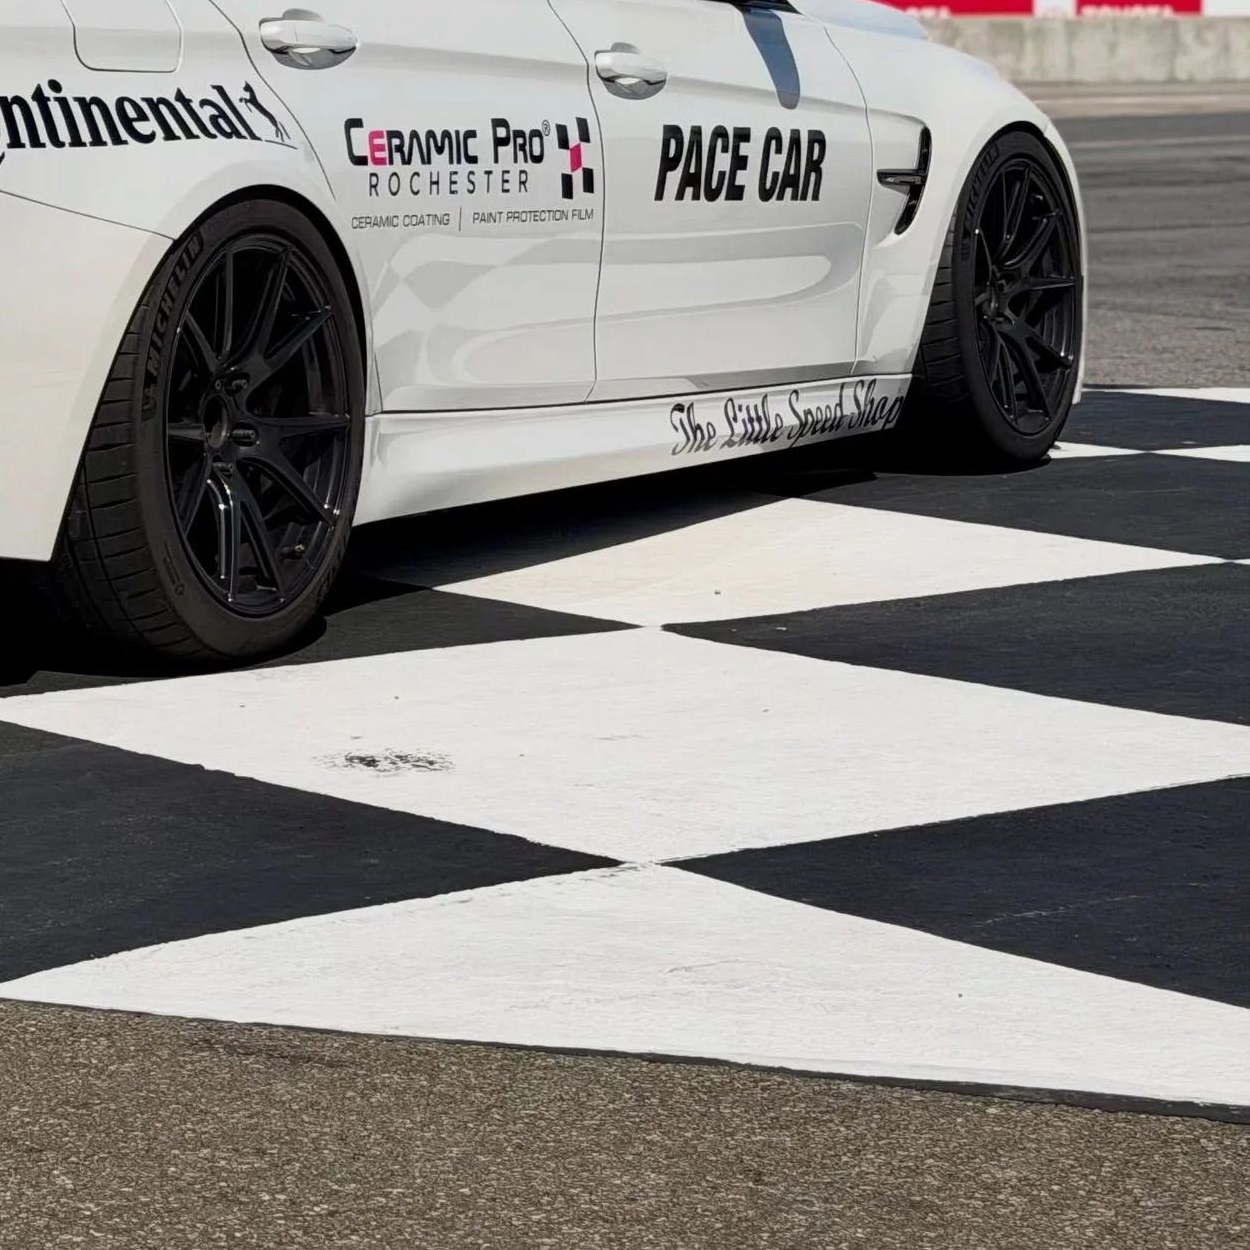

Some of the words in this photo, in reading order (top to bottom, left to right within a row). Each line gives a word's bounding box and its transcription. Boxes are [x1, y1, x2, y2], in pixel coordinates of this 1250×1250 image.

[368, 169, 529, 197] ROCHESTER
[654, 124, 751, 202] PACE
[758, 126, 827, 202] CAR
[351, 215, 399, 230] CERAMIC
[402, 212, 450, 228] COATING
[472, 211, 503, 224] PAINT
[506, 209, 569, 223] PROTECTION
[571, 208, 594, 221] FILM
[146, 235, 201, 377] MICHELIN
[670, 402, 717, 455] The
[720, 394, 783, 450] Little
[787, 383, 845, 447] Speed
[850, 378, 905, 430] Shop
